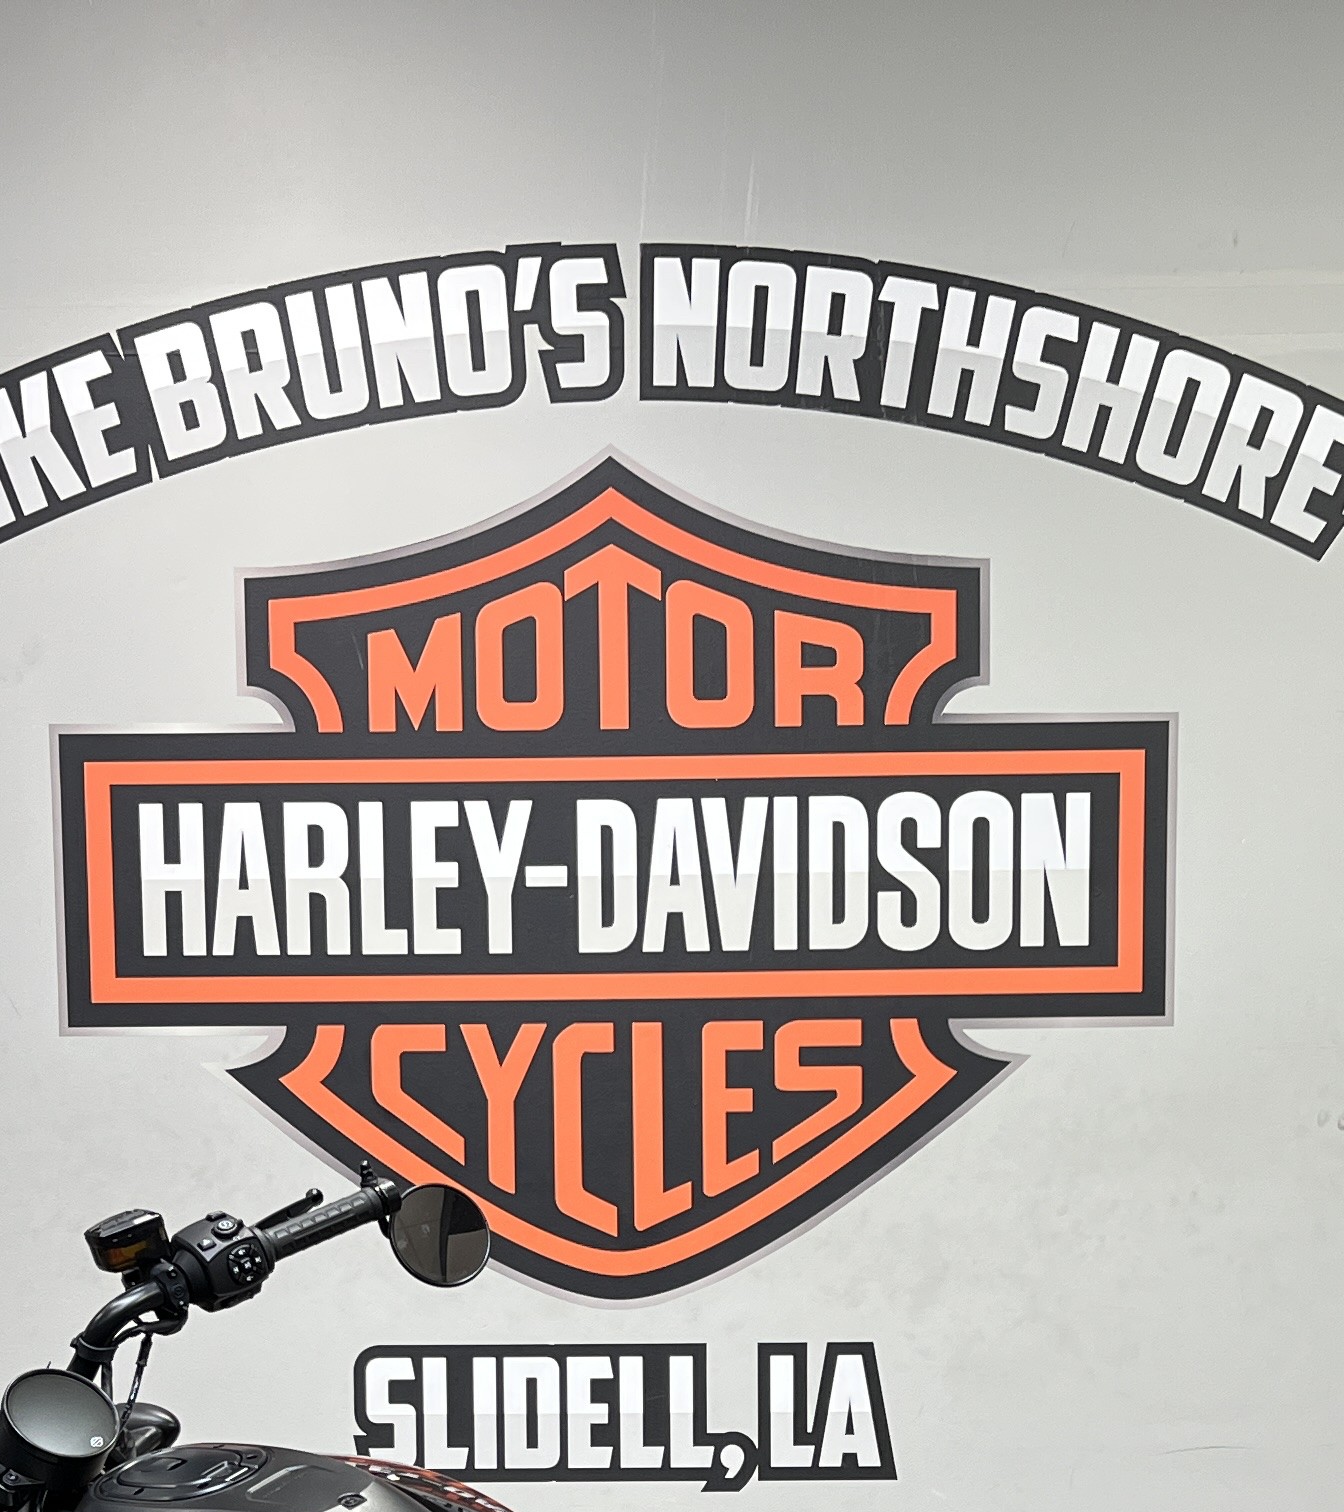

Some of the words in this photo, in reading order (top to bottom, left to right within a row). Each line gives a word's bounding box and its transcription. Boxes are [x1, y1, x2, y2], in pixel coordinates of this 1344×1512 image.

[133, 256, 612, 461] BRUNO'S
[366, 543, 864, 732] MOTOR
[138, 790, 1092, 957] HARLEY-DAVIDSON
[369, 1018, 863, 1237] CYCLES
[769, 1354, 882, 1467] LA
